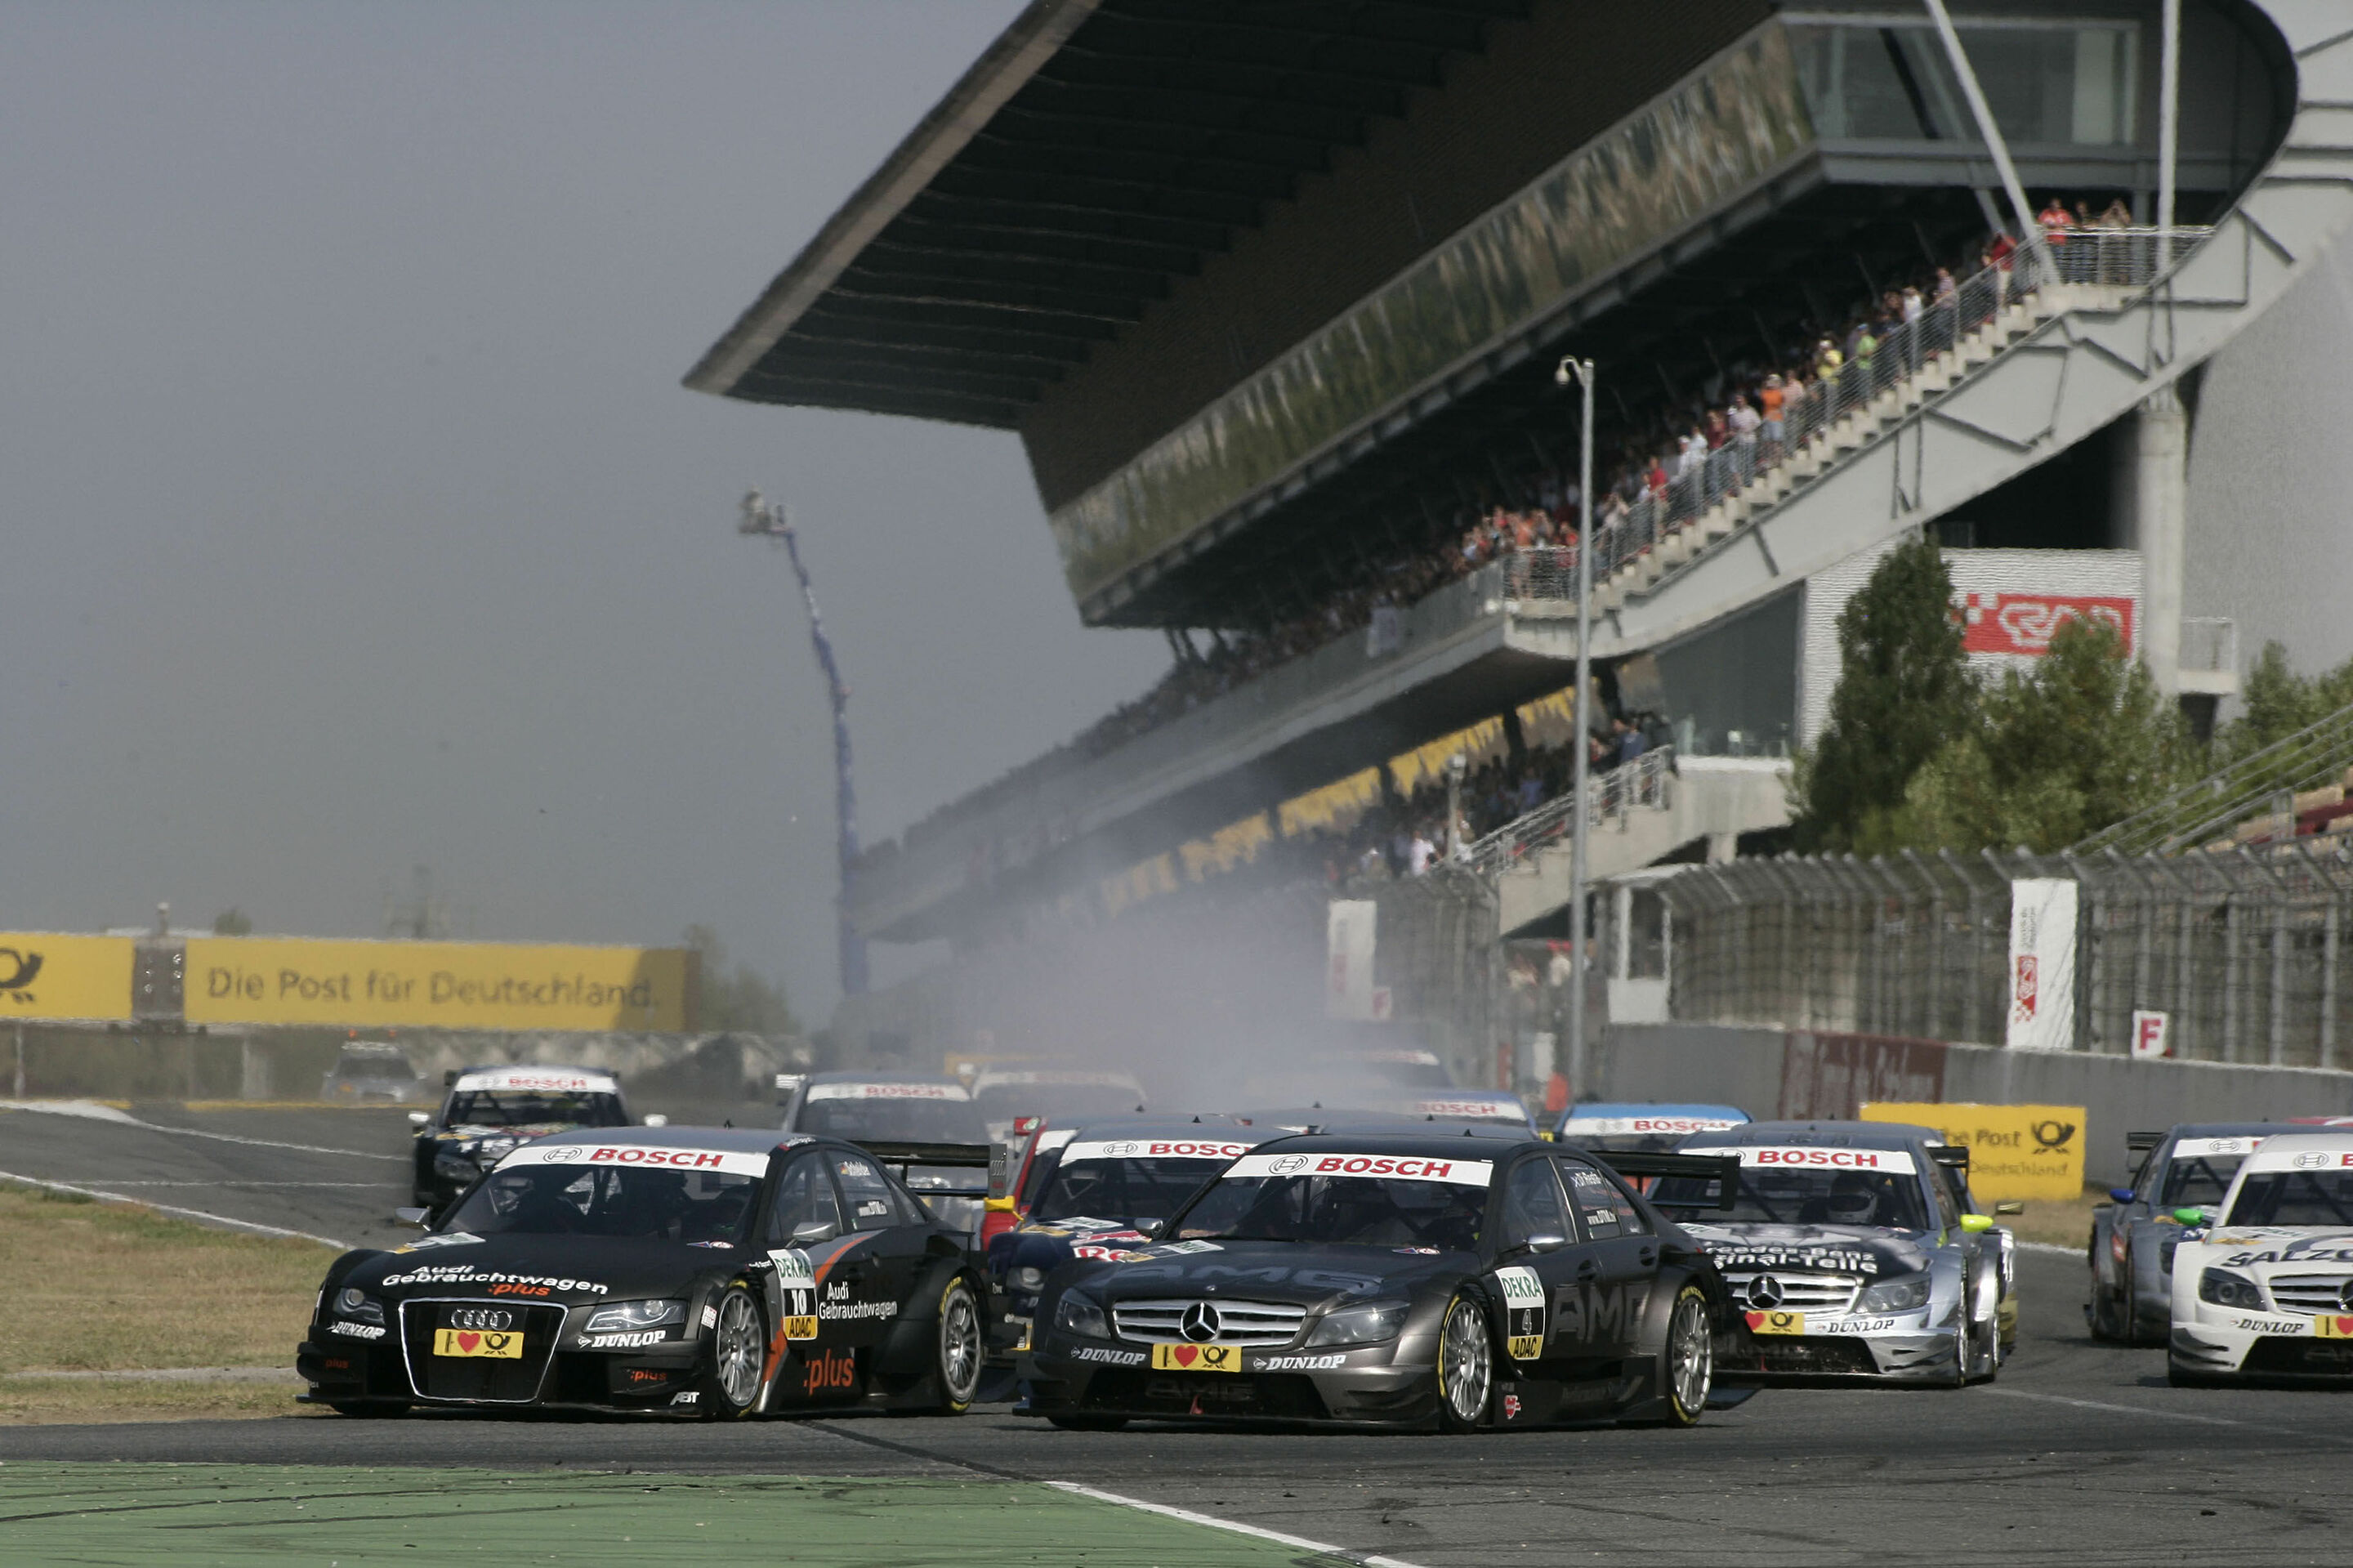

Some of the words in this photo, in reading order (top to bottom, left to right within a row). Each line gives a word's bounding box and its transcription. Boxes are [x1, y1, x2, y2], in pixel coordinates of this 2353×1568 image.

[209, 967, 264, 1000] Die
[279, 969, 351, 1003] Post
[368, 968, 416, 1003] für
[2139, 1018, 2162, 1050] F
[508, 1076, 587, 1089] BOSCH
[865, 1084, 945, 1097] BOSCH
[1976, 1128, 2020, 1147] Post
[589, 1148, 724, 1168] BOSCH
[1149, 1143, 1249, 1157] BOSC
[1757, 1150, 1878, 1167] BOSCH
[1315, 1157, 1452, 1177] BOSCH
[411, 1266, 475, 1275] Audi
[775, 1258, 813, 1278] DEKRA
[382, 1272, 608, 1295] Gebrauchtwagen
[827, 1281, 849, 1300] Audi
[1502, 1276, 1542, 1298] DEKRA
[791, 1289, 807, 1316] 10
[819, 1300, 897, 1320] Gebrauchtwagen
[332, 1321, 386, 1340] DUNLOP
[788, 1318, 811, 1338] ADAC
[1522, 1309, 1532, 1334] 4
[1828, 1320, 1895, 1333] DUNLOP
[2239, 1319, 2304, 1333] DUNLOP
[592, 1330, 666, 1347] DUNLOP
[1513, 1337, 1537, 1358] ADAC
[1078, 1348, 1145, 1365] DUNLOP
[1266, 1355, 1346, 1370] DUNLOP
[669, 1391, 700, 1405] ABT
